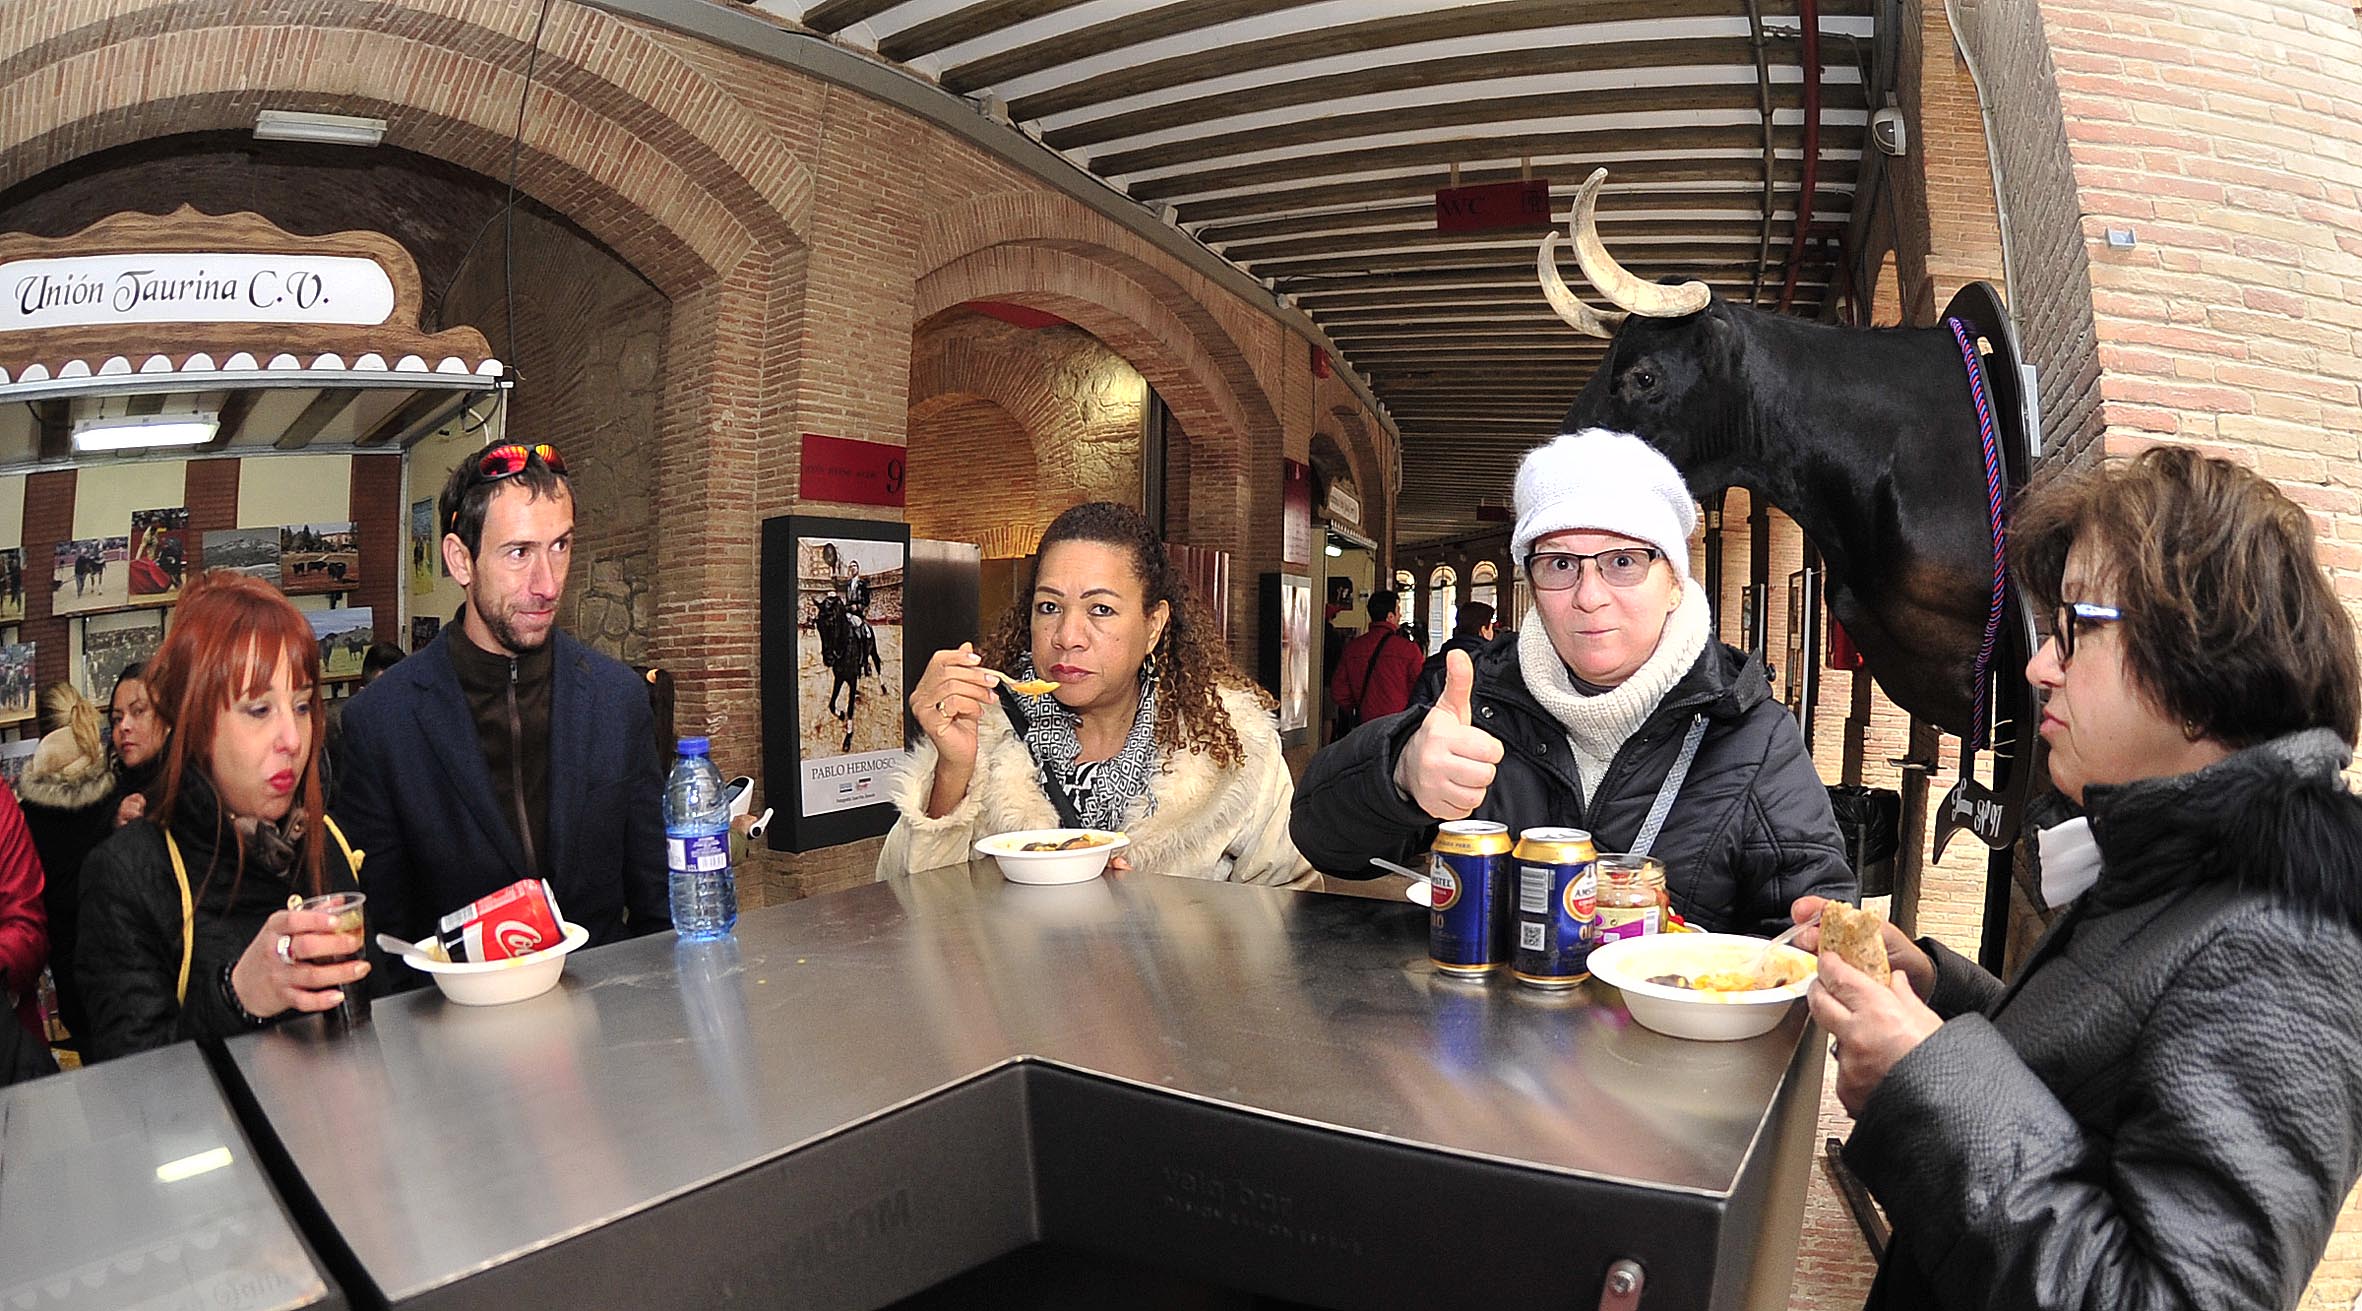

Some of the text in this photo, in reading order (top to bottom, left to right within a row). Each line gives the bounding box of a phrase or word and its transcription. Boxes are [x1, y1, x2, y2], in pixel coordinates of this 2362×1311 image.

[15, 273, 104, 315] Unión
[113, 270, 237, 312] Taurina
[886, 459, 904, 494] 9
[811, 764, 845, 779] PABLO
